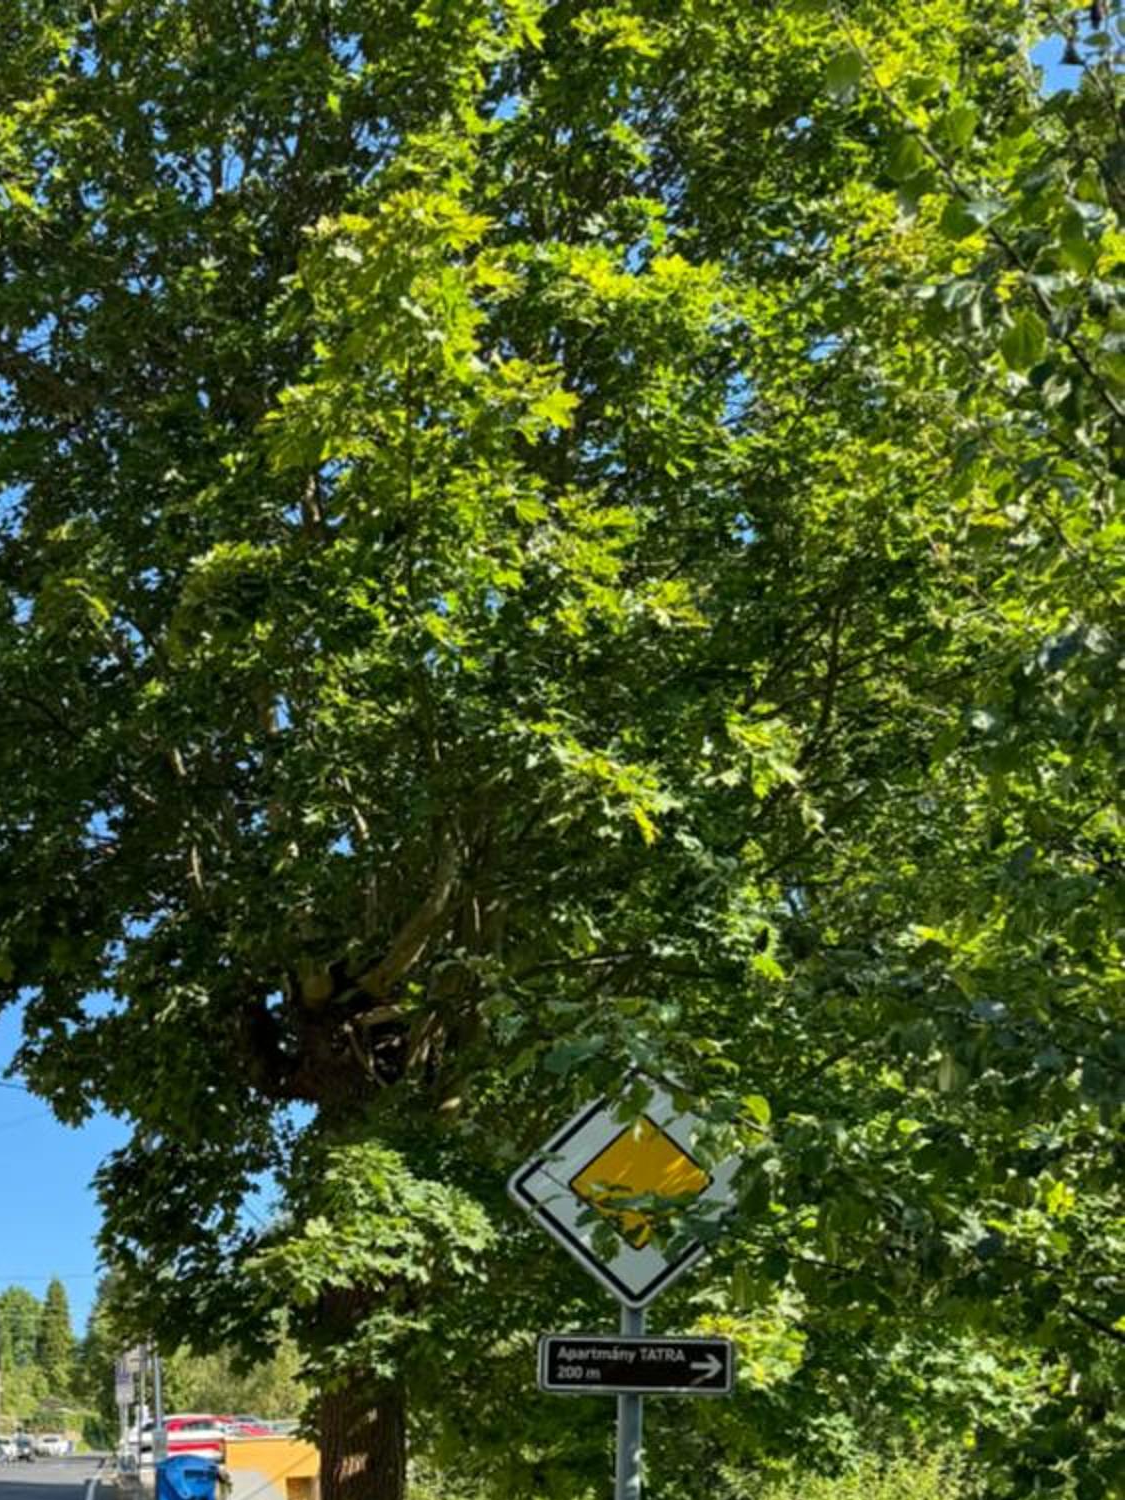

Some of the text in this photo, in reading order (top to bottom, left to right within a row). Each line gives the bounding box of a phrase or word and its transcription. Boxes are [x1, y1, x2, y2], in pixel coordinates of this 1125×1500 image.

[557, 1346, 686, 1363] Apartmány TATRA
[557, 1366, 601, 1380] 200 m
